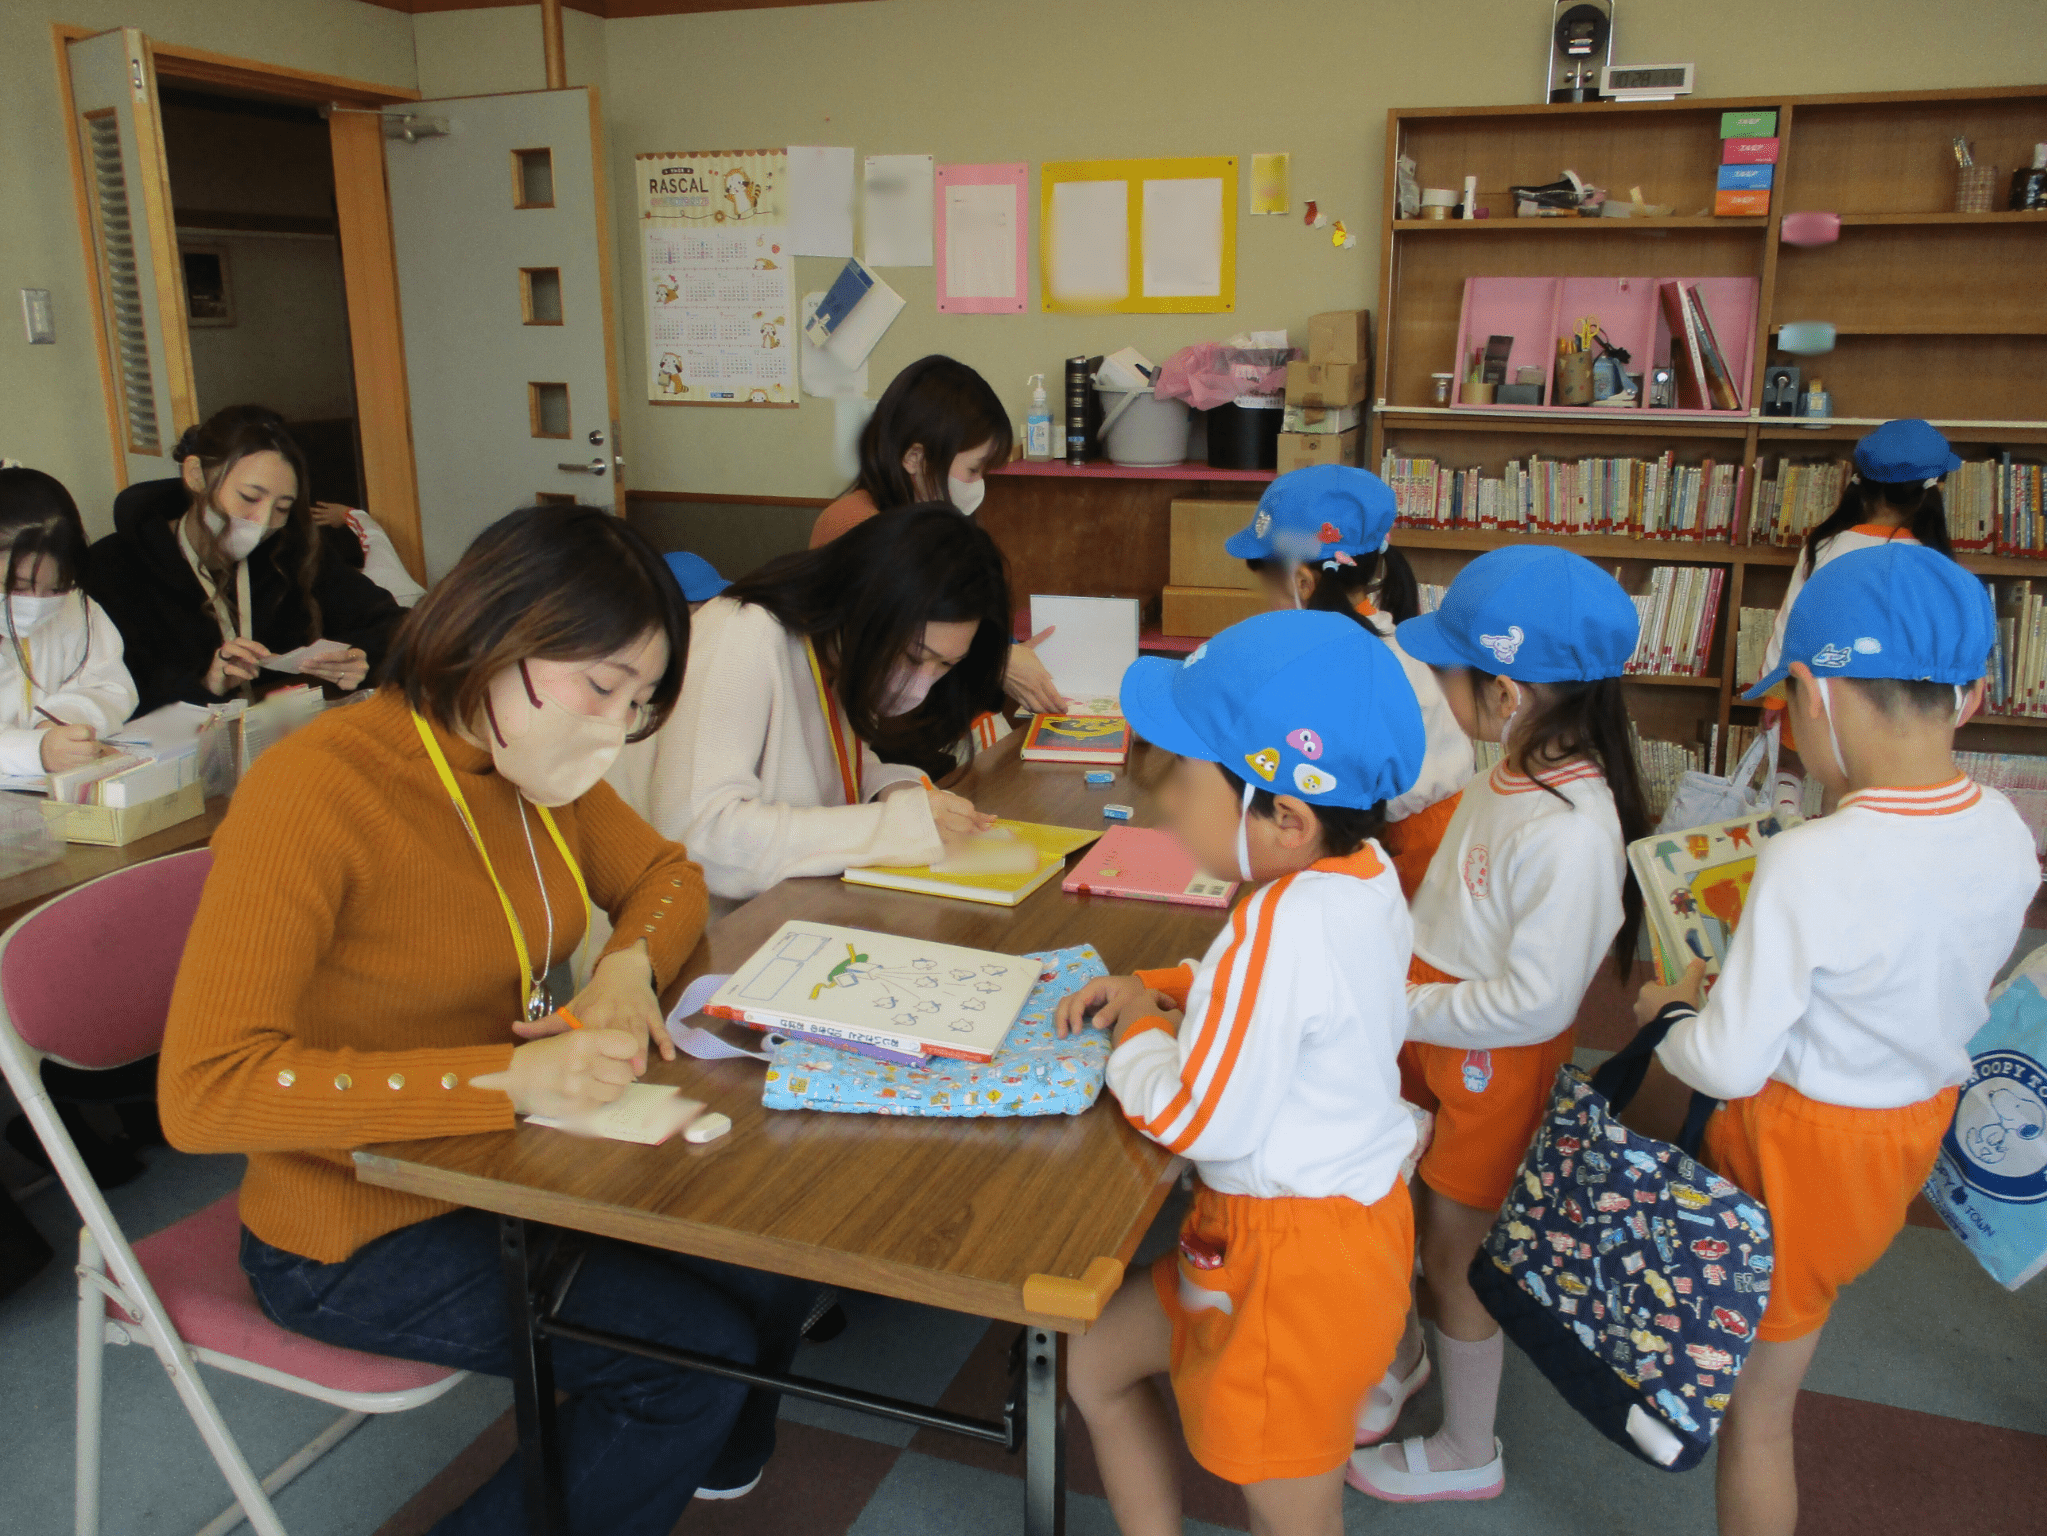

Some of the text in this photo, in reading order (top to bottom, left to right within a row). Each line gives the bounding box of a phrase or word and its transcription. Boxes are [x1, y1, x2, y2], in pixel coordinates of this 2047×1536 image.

[650, 178, 709, 194] RASCAL
[780, 1019, 805, 1031] おばけ
[848, 1031, 899, 1048] おじいさんと
[1965, 1205, 1996, 1237] TOWN
